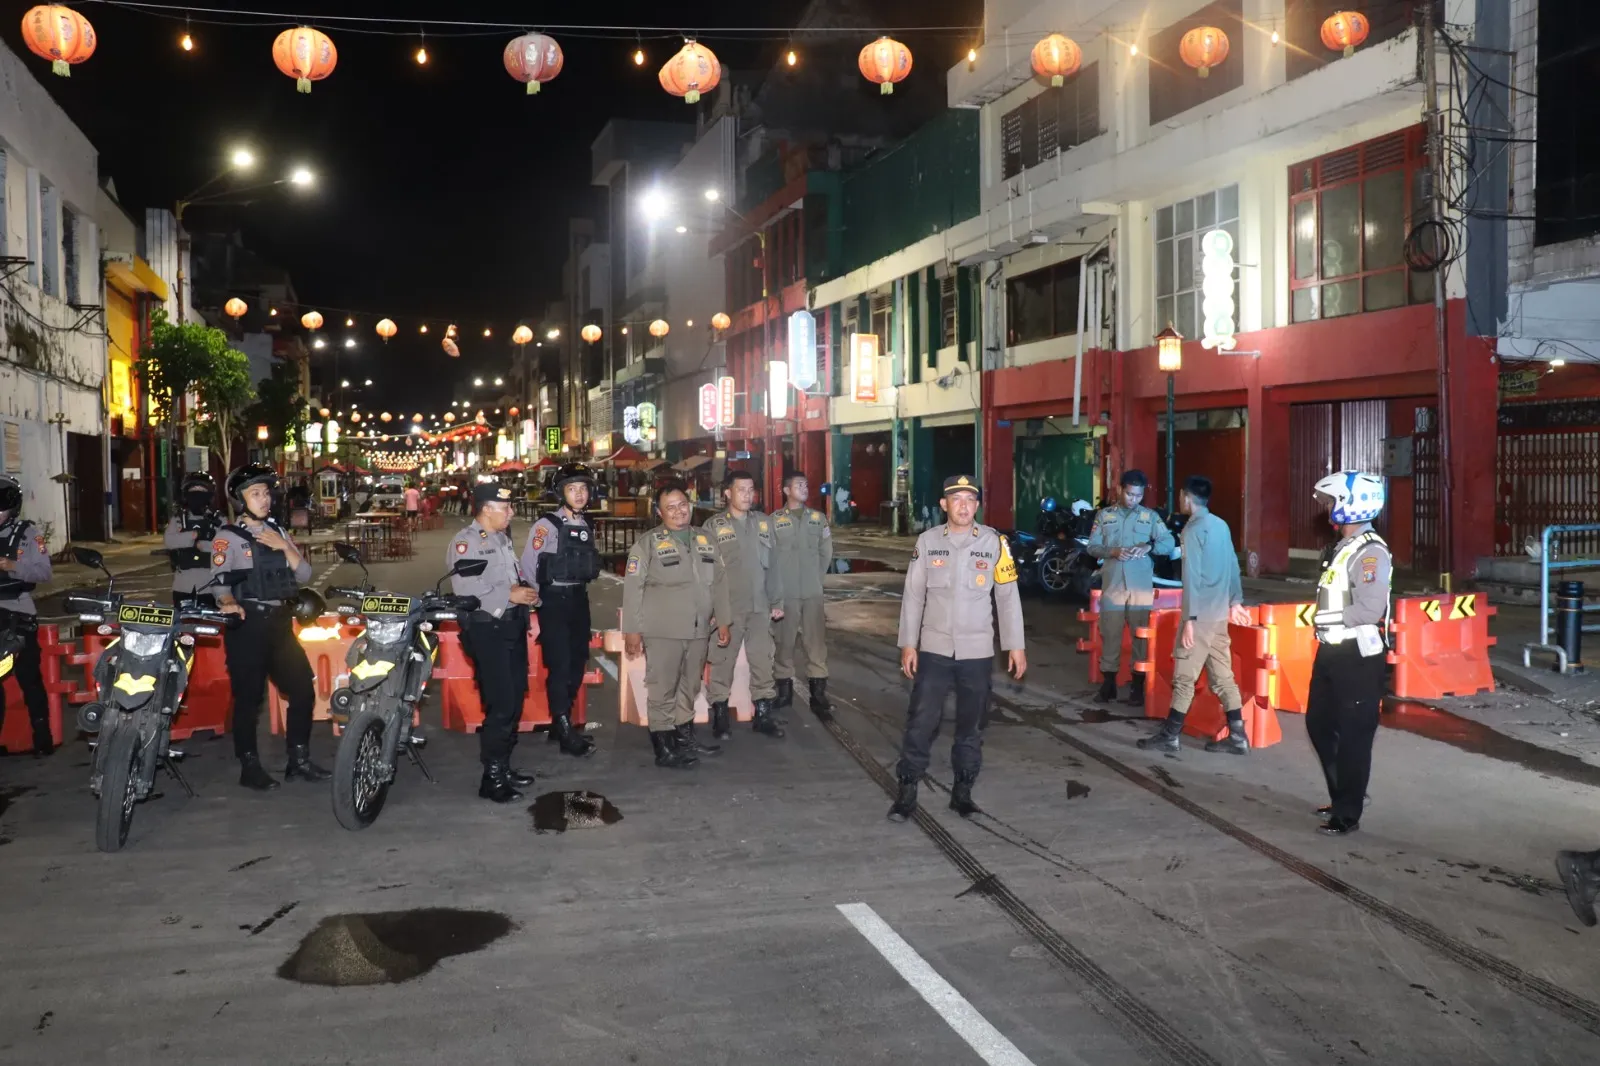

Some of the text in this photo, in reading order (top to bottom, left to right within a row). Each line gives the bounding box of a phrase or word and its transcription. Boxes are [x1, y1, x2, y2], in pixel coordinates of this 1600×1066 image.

[970, 551, 993, 559] POLRI
[380, 604, 408, 612] 1051-32
[140, 615, 171, 624] 1049-32
